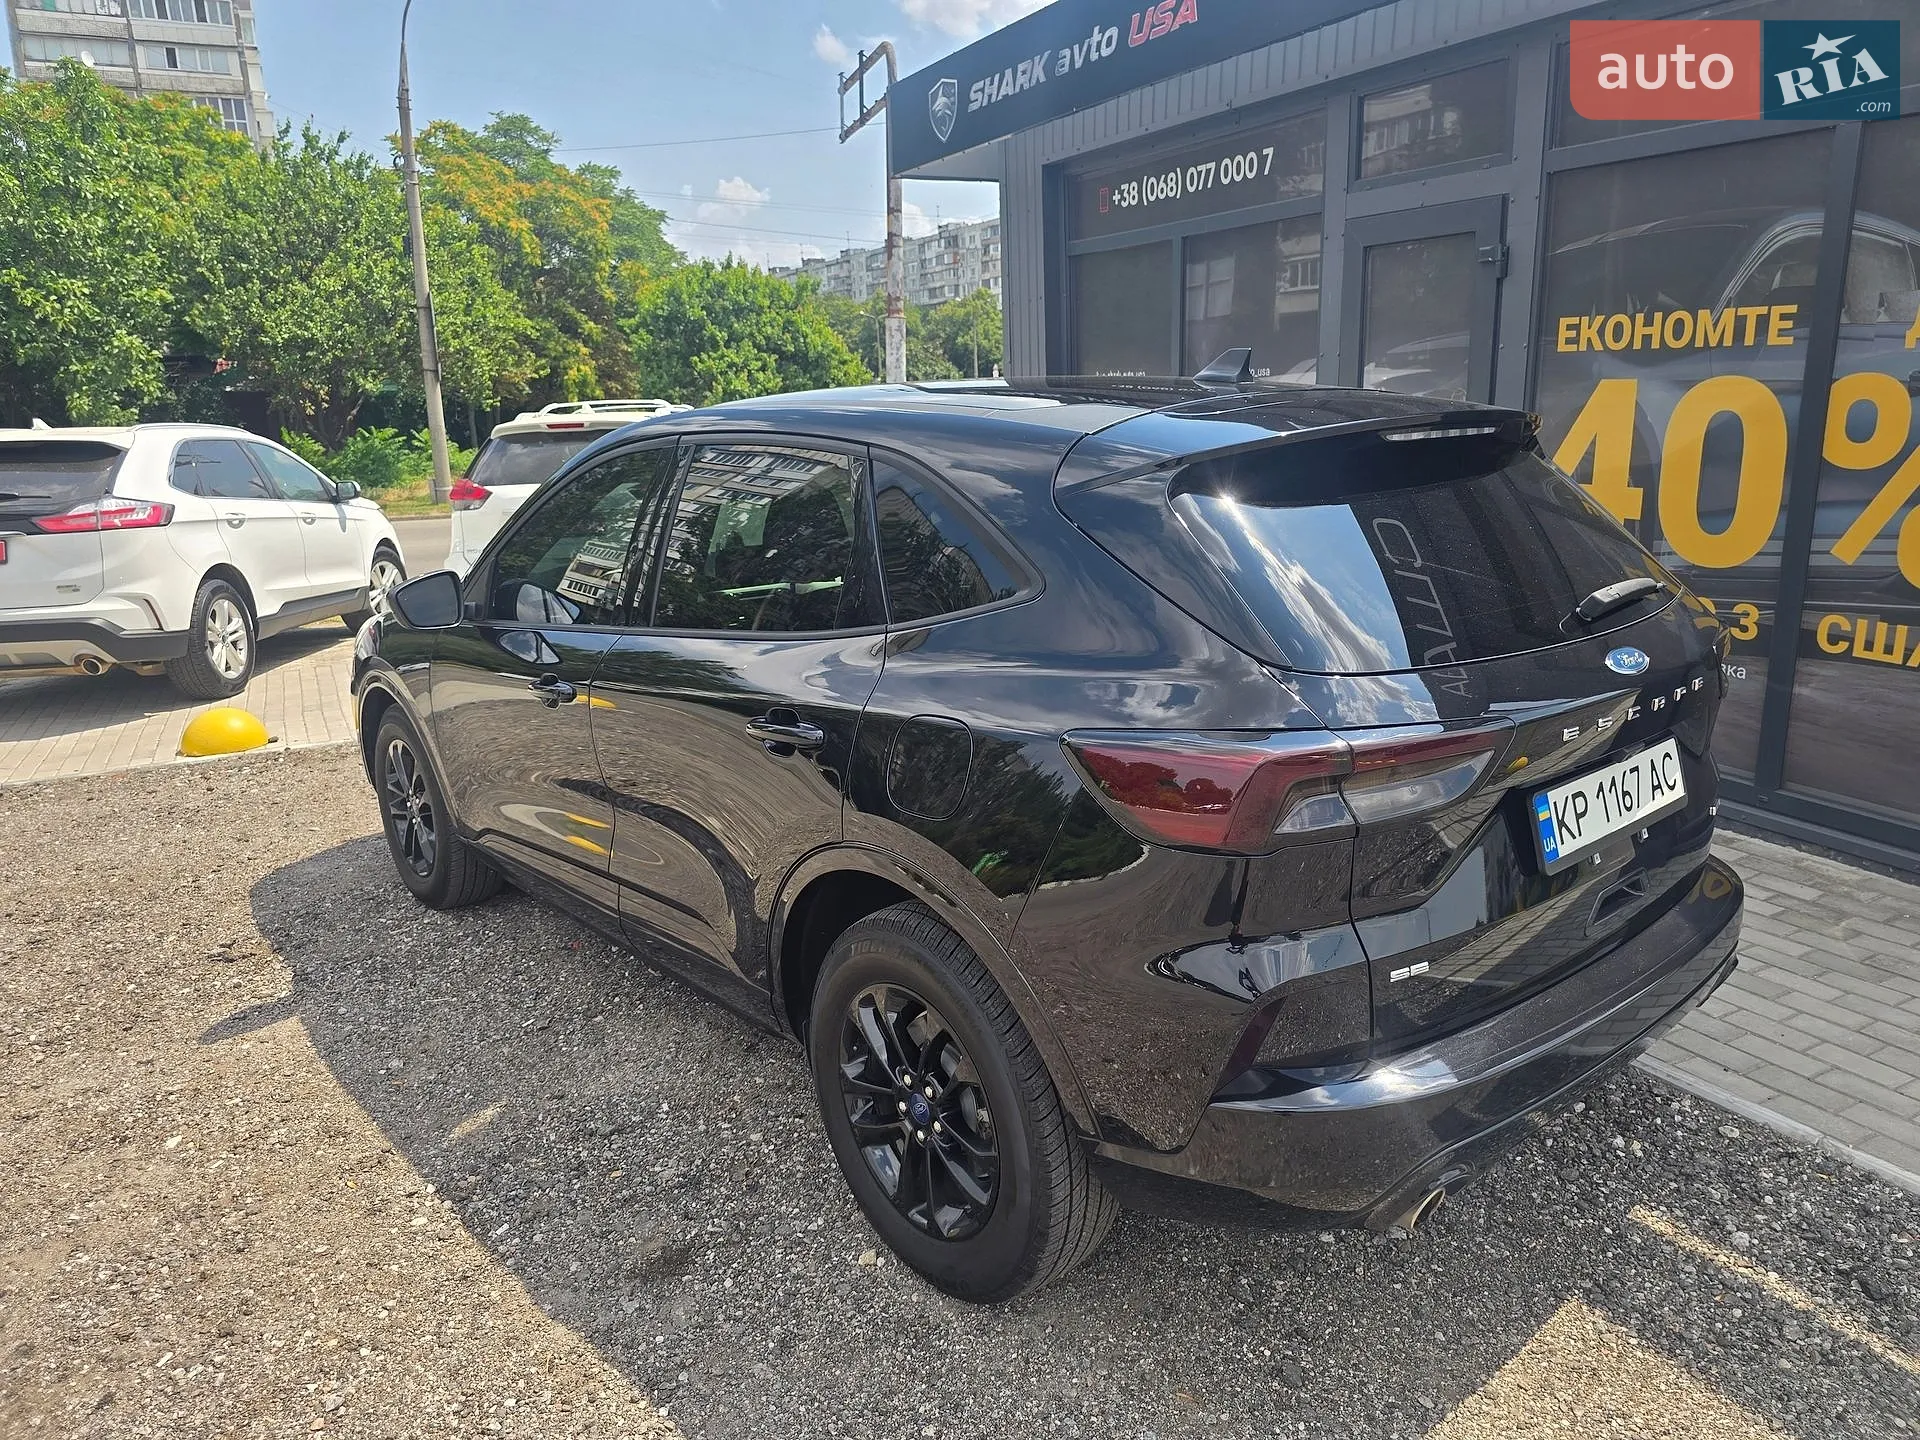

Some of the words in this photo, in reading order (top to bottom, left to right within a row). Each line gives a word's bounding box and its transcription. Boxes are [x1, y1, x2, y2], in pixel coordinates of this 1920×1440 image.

[967, 50, 1051, 113] SHARK
[1055, 25, 1120, 77] avto
[1128, 0, 1199, 48] USA
[1112, 181, 1139, 208] +38
[1142, 167, 1182, 206] (068)
[1186, 161, 1216, 193] 077
[1220, 151, 1258, 185] 000
[1262, 146, 1274, 176] 7
[1556, 304, 1798, 353] ЕКОНОМТЕ
[1816, 613, 1920, 669] СШ
[1562, 675, 1704, 742] ESCAPE
[1553, 789, 1589, 845] KP
[1596, 766, 1641, 823] 1167
[1649, 752, 1677, 802] AC
[1543, 840, 1557, 853] UA
[1390, 961, 1430, 983] SE
